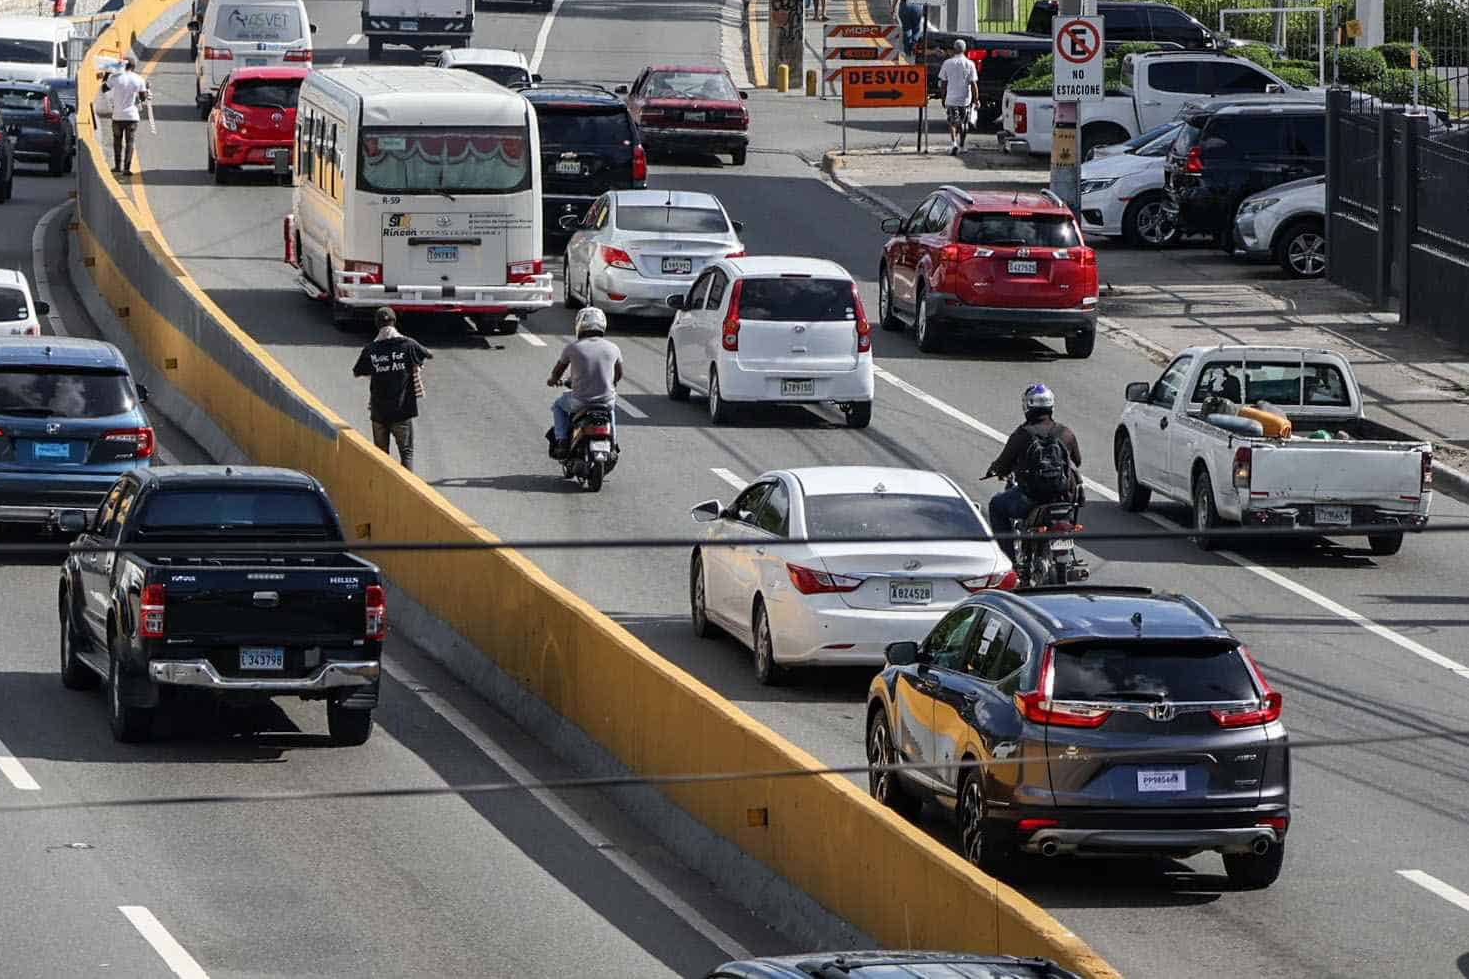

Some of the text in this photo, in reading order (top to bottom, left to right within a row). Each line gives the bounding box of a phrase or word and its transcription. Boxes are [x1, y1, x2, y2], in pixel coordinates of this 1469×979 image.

[848, 71, 920, 85] DESVIO
[1072, 69, 1085, 80] NO
[1056, 84, 1101, 96] ESTACIONE
